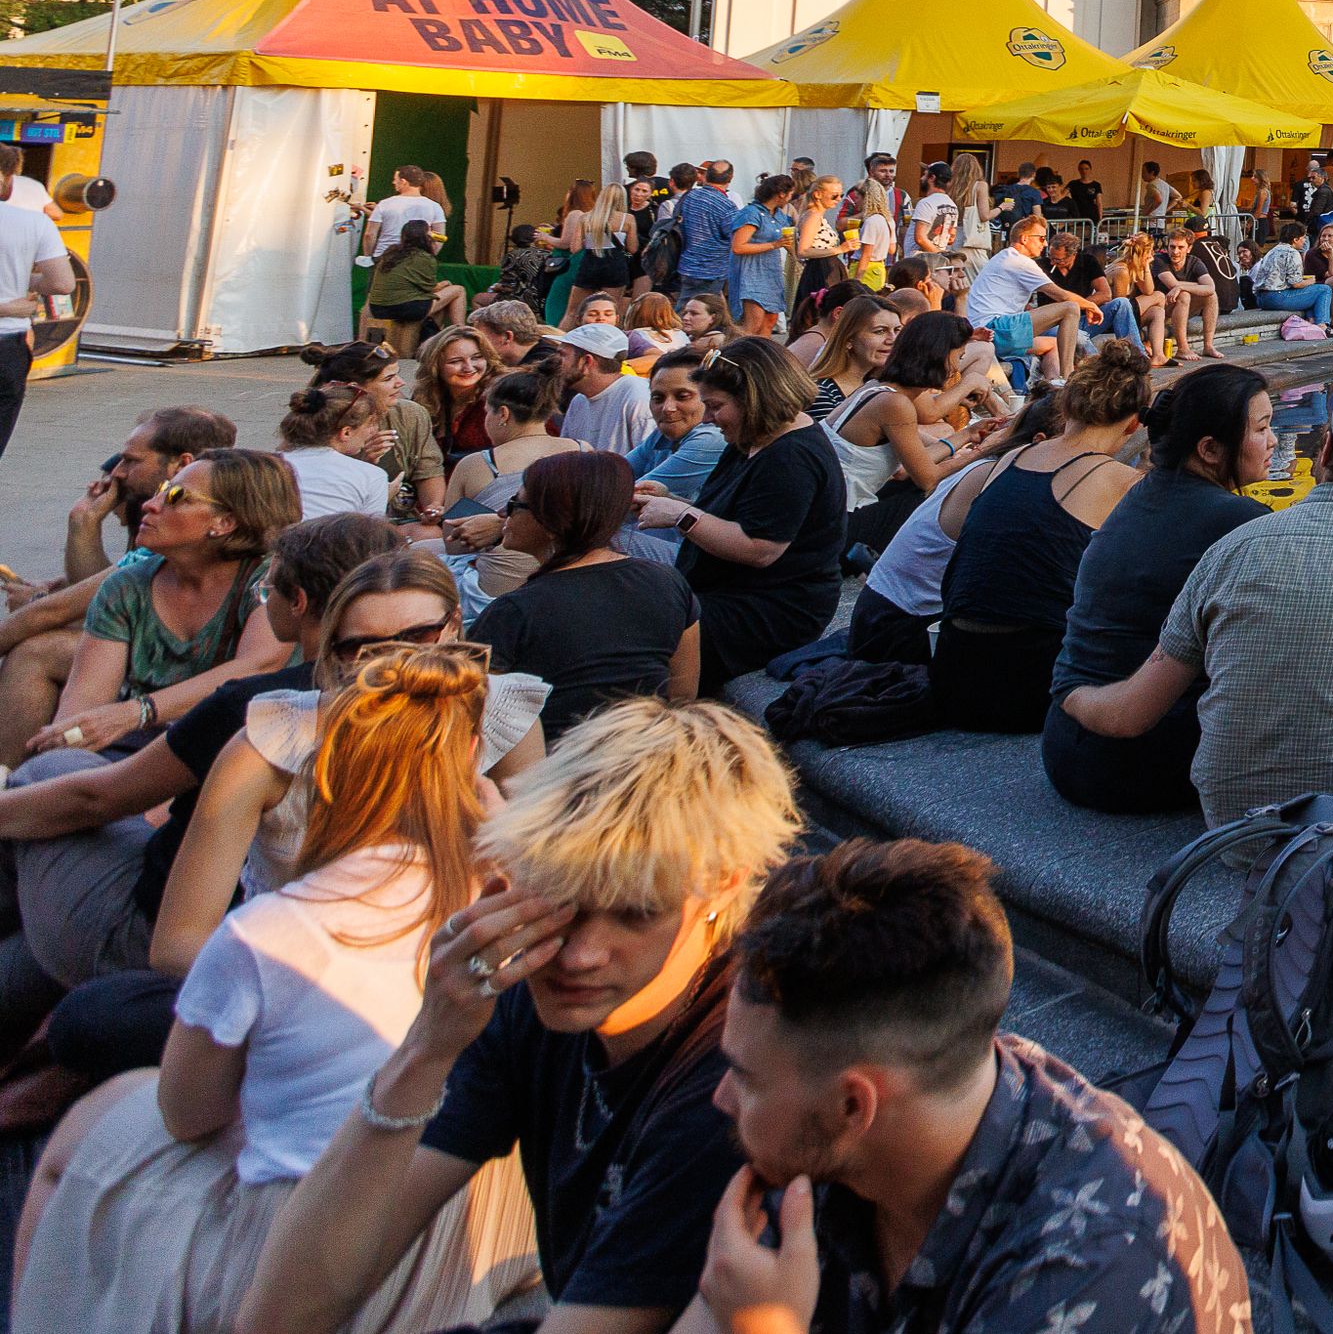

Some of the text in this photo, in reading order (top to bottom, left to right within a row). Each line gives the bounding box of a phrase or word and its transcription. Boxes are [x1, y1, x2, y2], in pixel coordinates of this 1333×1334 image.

[409, 17, 573, 58] BABY
[596, 48, 632, 58] FM4
[1144, 124, 1197, 140] Ottakringer
[1275, 129, 1310, 140] Ottakringer
